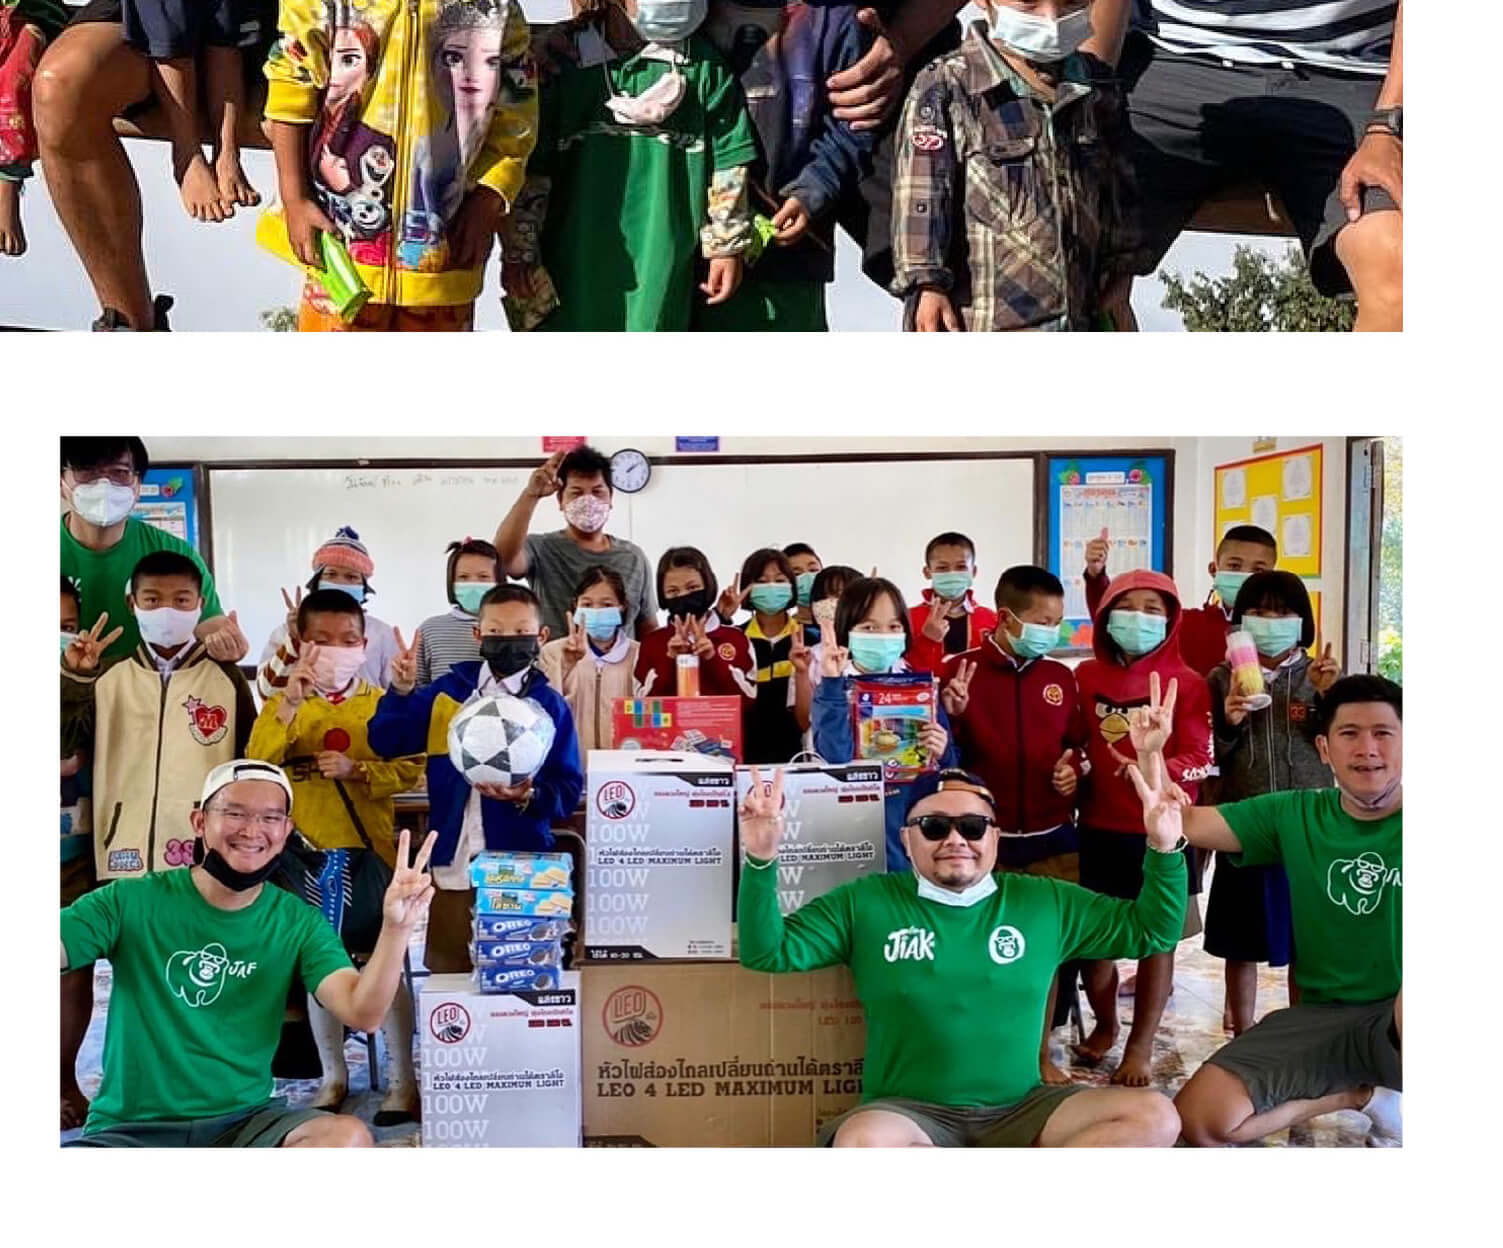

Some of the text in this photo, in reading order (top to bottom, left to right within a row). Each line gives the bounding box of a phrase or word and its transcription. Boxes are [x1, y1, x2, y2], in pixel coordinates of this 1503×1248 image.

[604, 785, 625, 802] LEO
[589, 824, 649, 843] 100W
[802, 853, 843, 861] MAXIMUM
[588, 868, 649, 888] 100W
[588, 893, 649, 912] 100W
[228, 960, 257, 978] JAF
[613, 992, 645, 1020] LEO
[437, 1007, 459, 1025] LEO
[424, 1047, 488, 1067] 100W
[598, 1055, 864, 1079] หัวไฟส่องไกลเปลี่ยนถ่านได้ตราลี
[455, 1082, 461, 1090] 4
[464, 1081, 482, 1089] LED
[486, 1080, 532, 1089] MAXIMUM
[536, 1079, 564, 1087] LIGHT
[598, 1079, 864, 1098] LEO 4 LED MAXIMUM LIG
[424, 1094, 488, 1114] 100W
[424, 1120, 489, 1140] 100W
